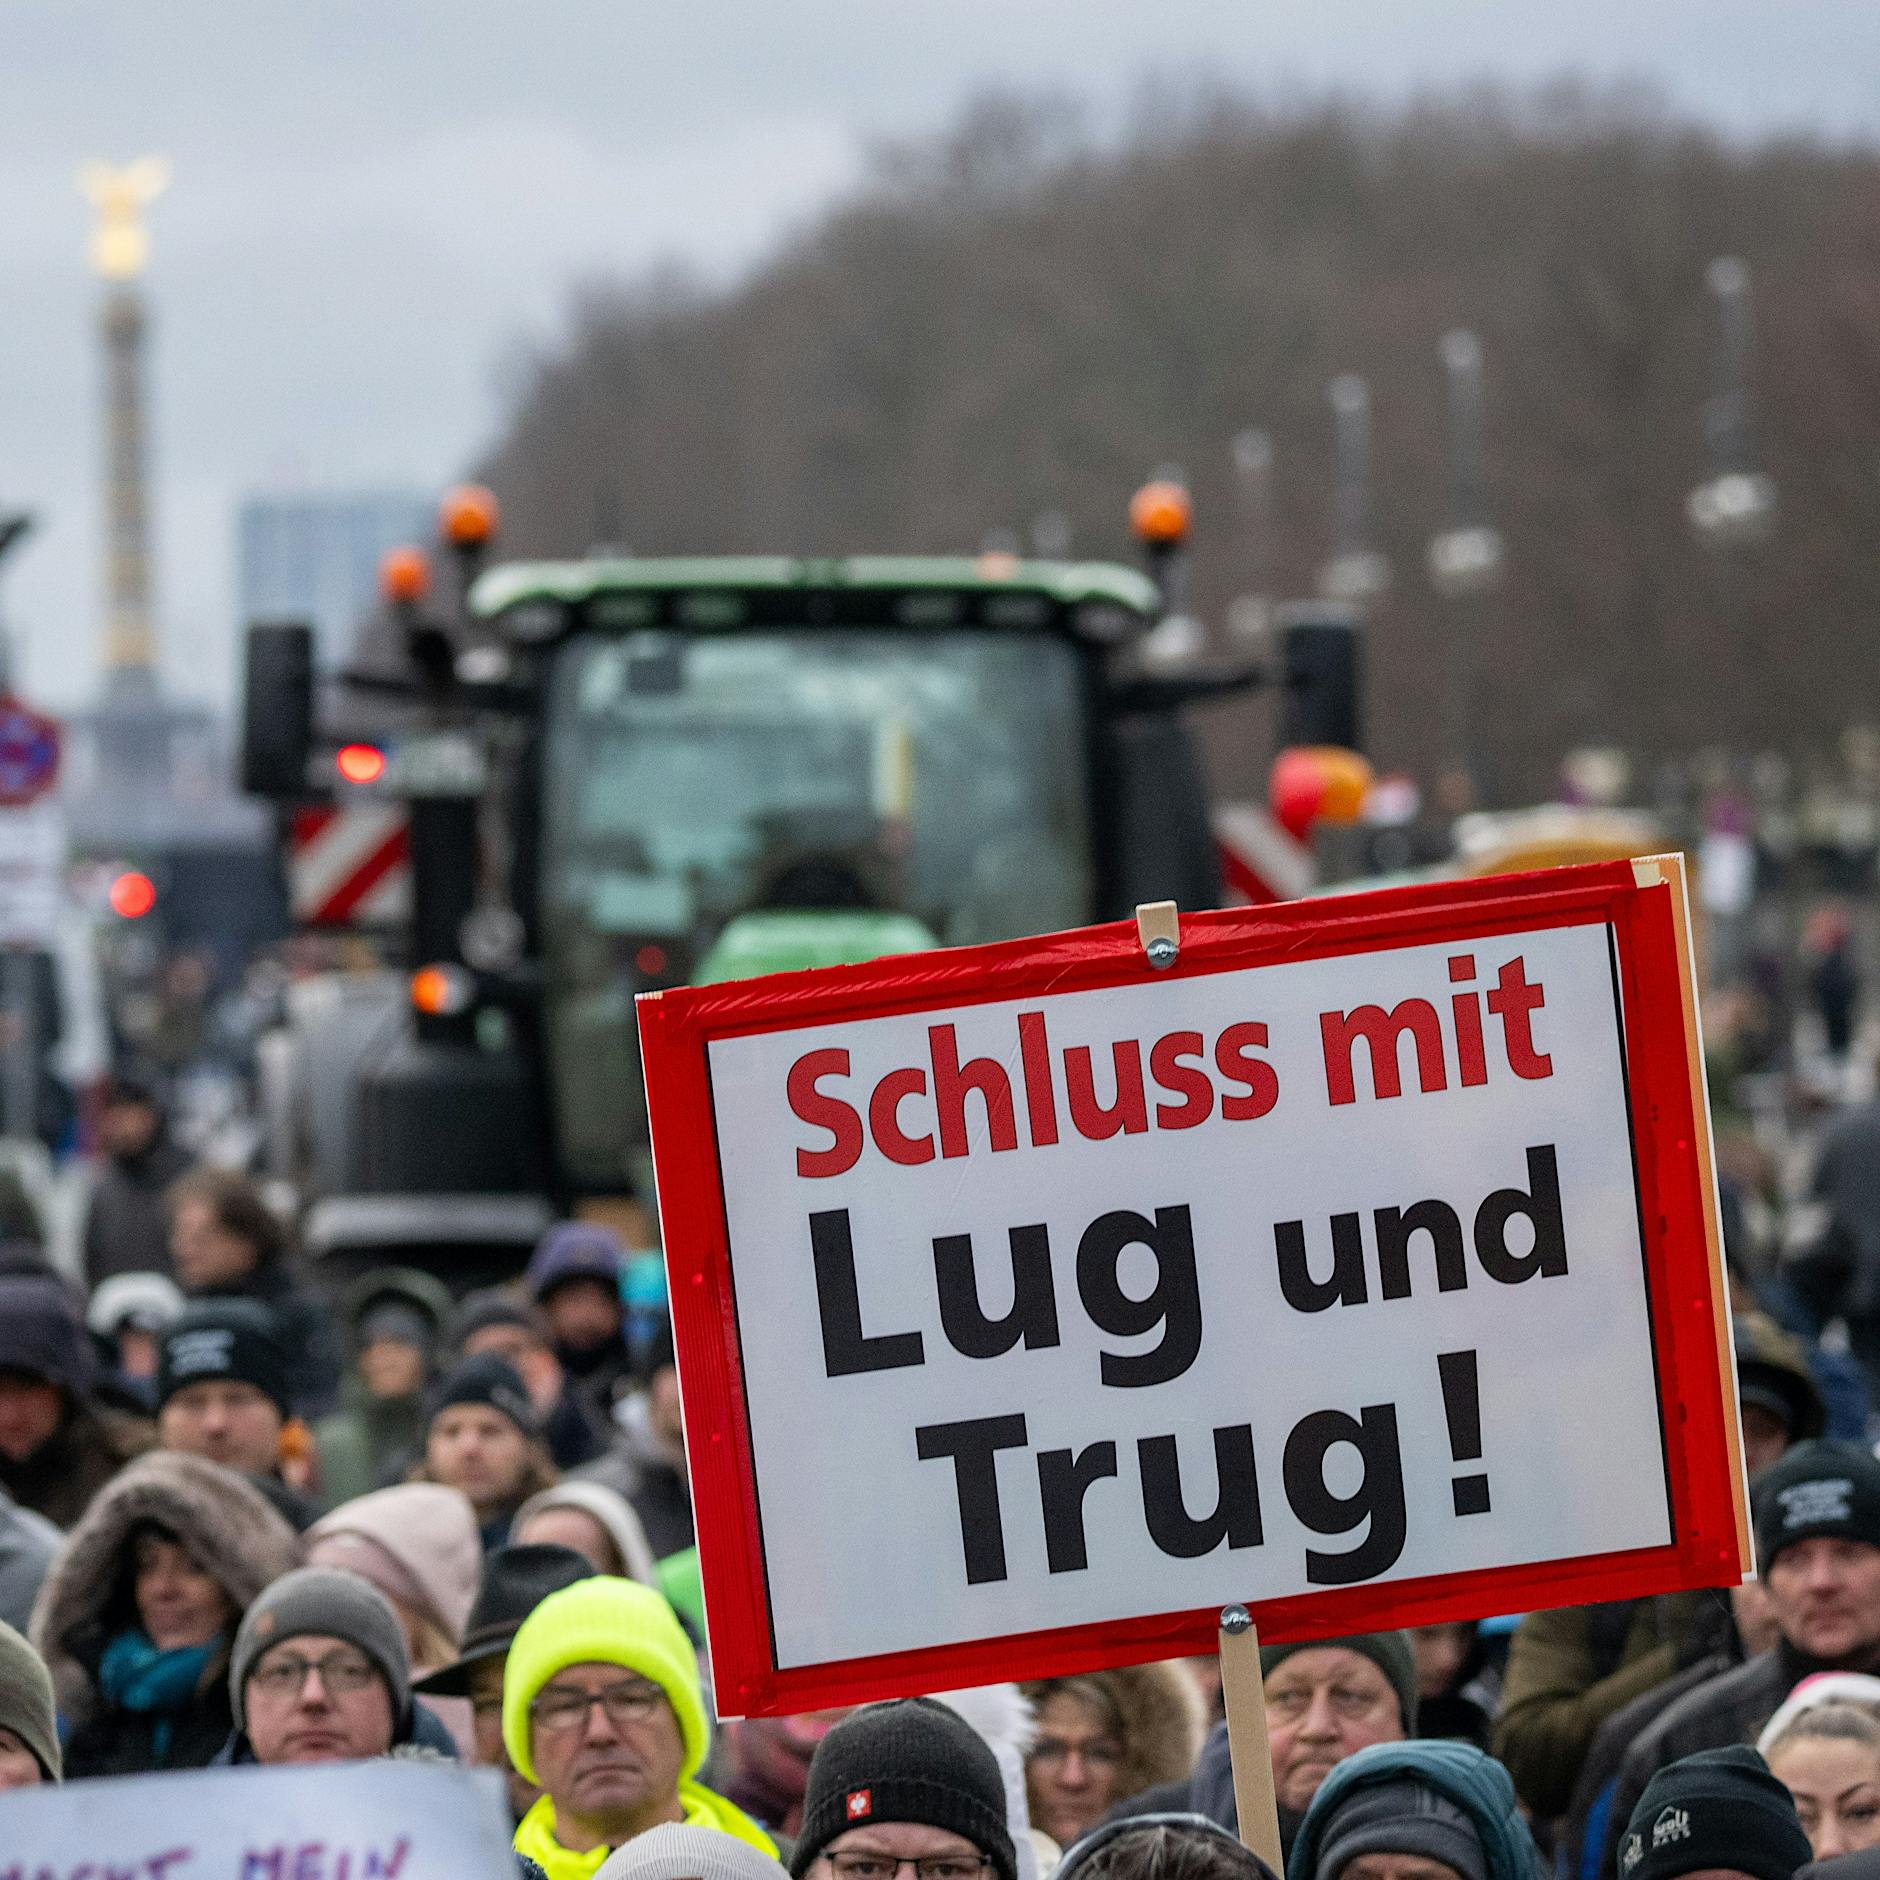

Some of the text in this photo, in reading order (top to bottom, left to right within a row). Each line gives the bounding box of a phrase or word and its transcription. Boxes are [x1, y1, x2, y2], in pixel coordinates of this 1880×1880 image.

[787, 953, 1554, 1179] Schluss mit
[808, 1143, 1569, 1389] Lug und
[914, 1348, 1492, 1587] Trug!
